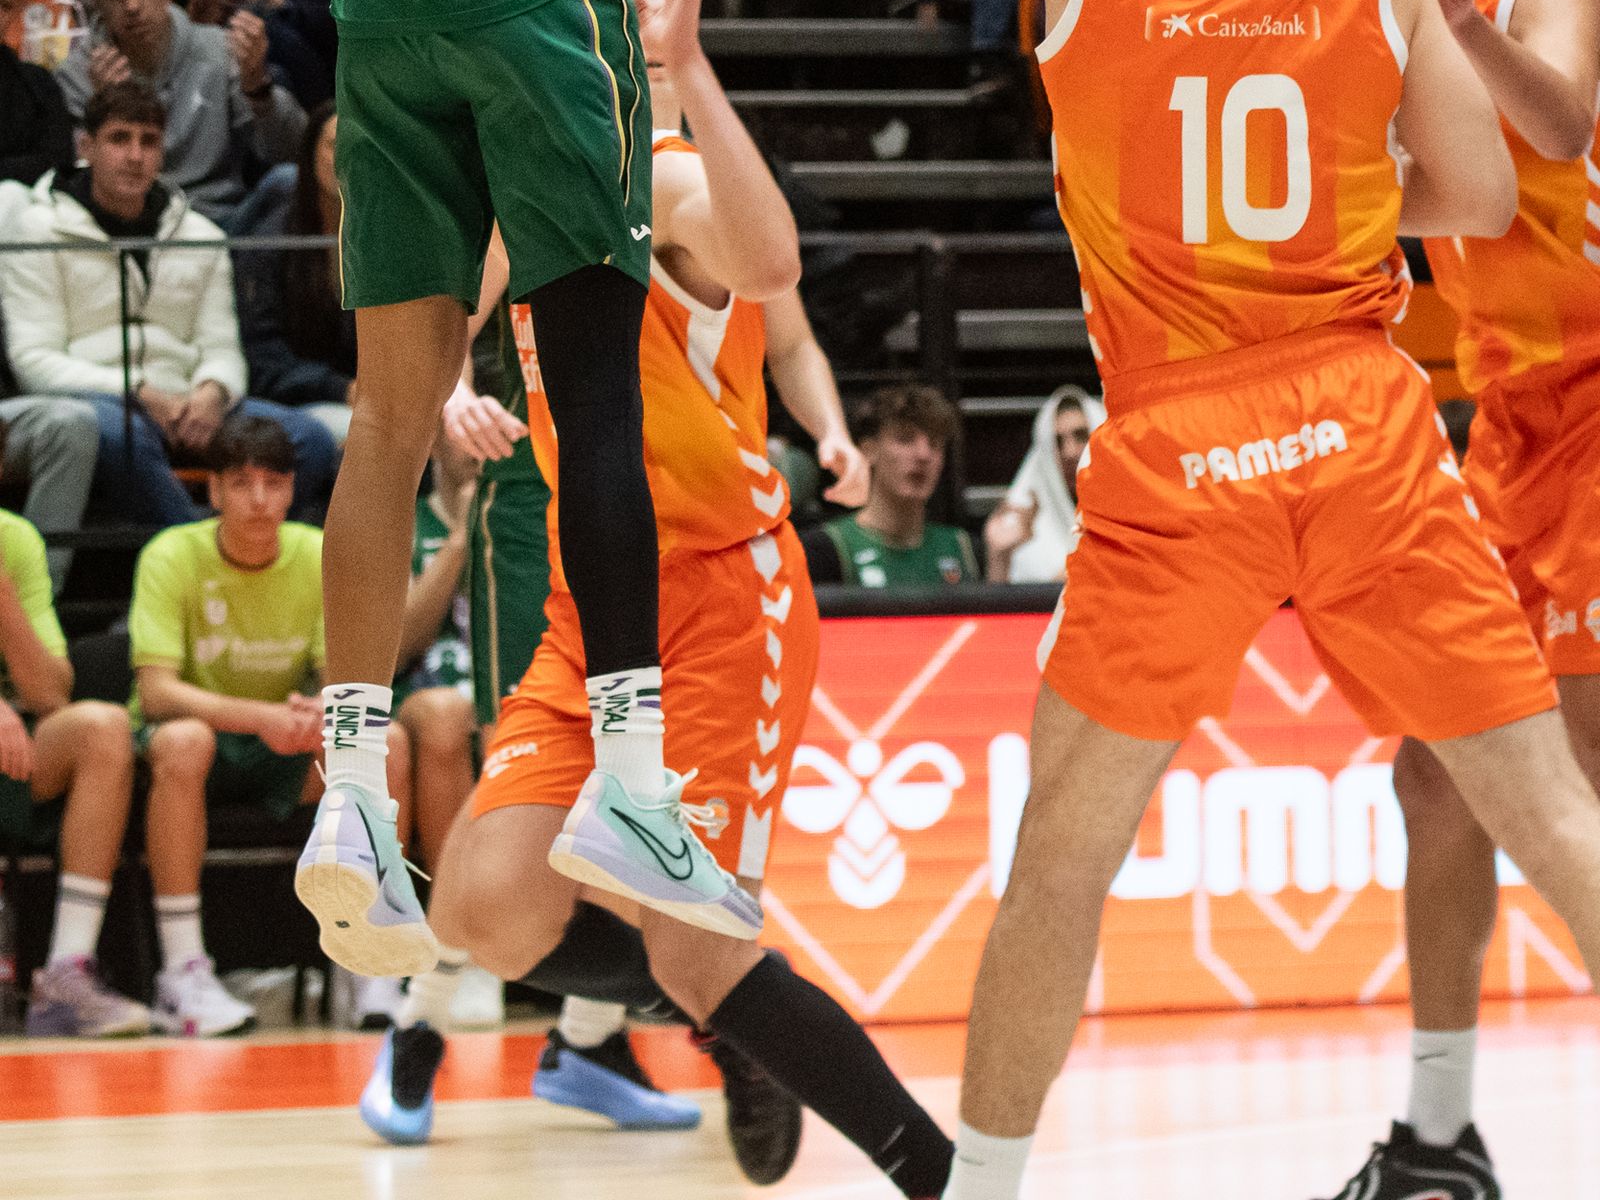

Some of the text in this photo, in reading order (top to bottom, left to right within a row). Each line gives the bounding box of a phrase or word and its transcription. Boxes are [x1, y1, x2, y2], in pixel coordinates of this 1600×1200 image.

[1197, 13, 1306, 38] CaixaBank
[1168, 73, 1312, 245] 10
[1179, 419, 1348, 490] PAMESA
